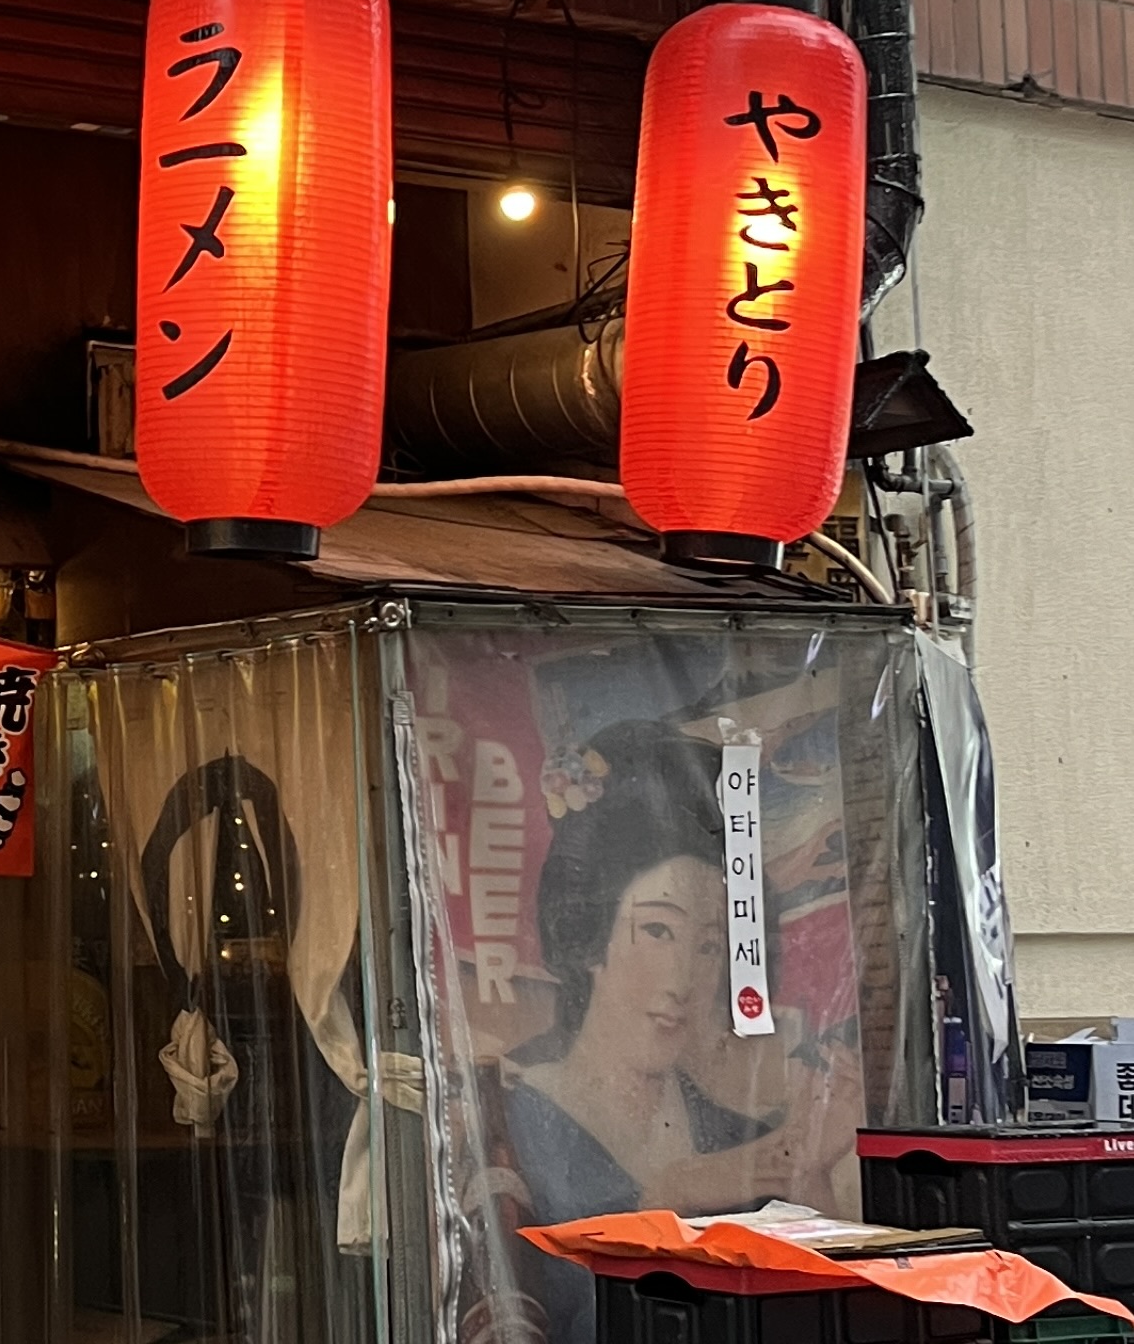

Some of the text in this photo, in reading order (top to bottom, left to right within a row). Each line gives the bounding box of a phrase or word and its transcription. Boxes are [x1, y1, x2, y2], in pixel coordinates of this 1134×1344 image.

[159, 22, 247, 401] ラーメン
[724, 89, 822, 421] やきとり
[469, 737, 526, 1004] BEER
[728, 768, 761, 967] 야타이미세
